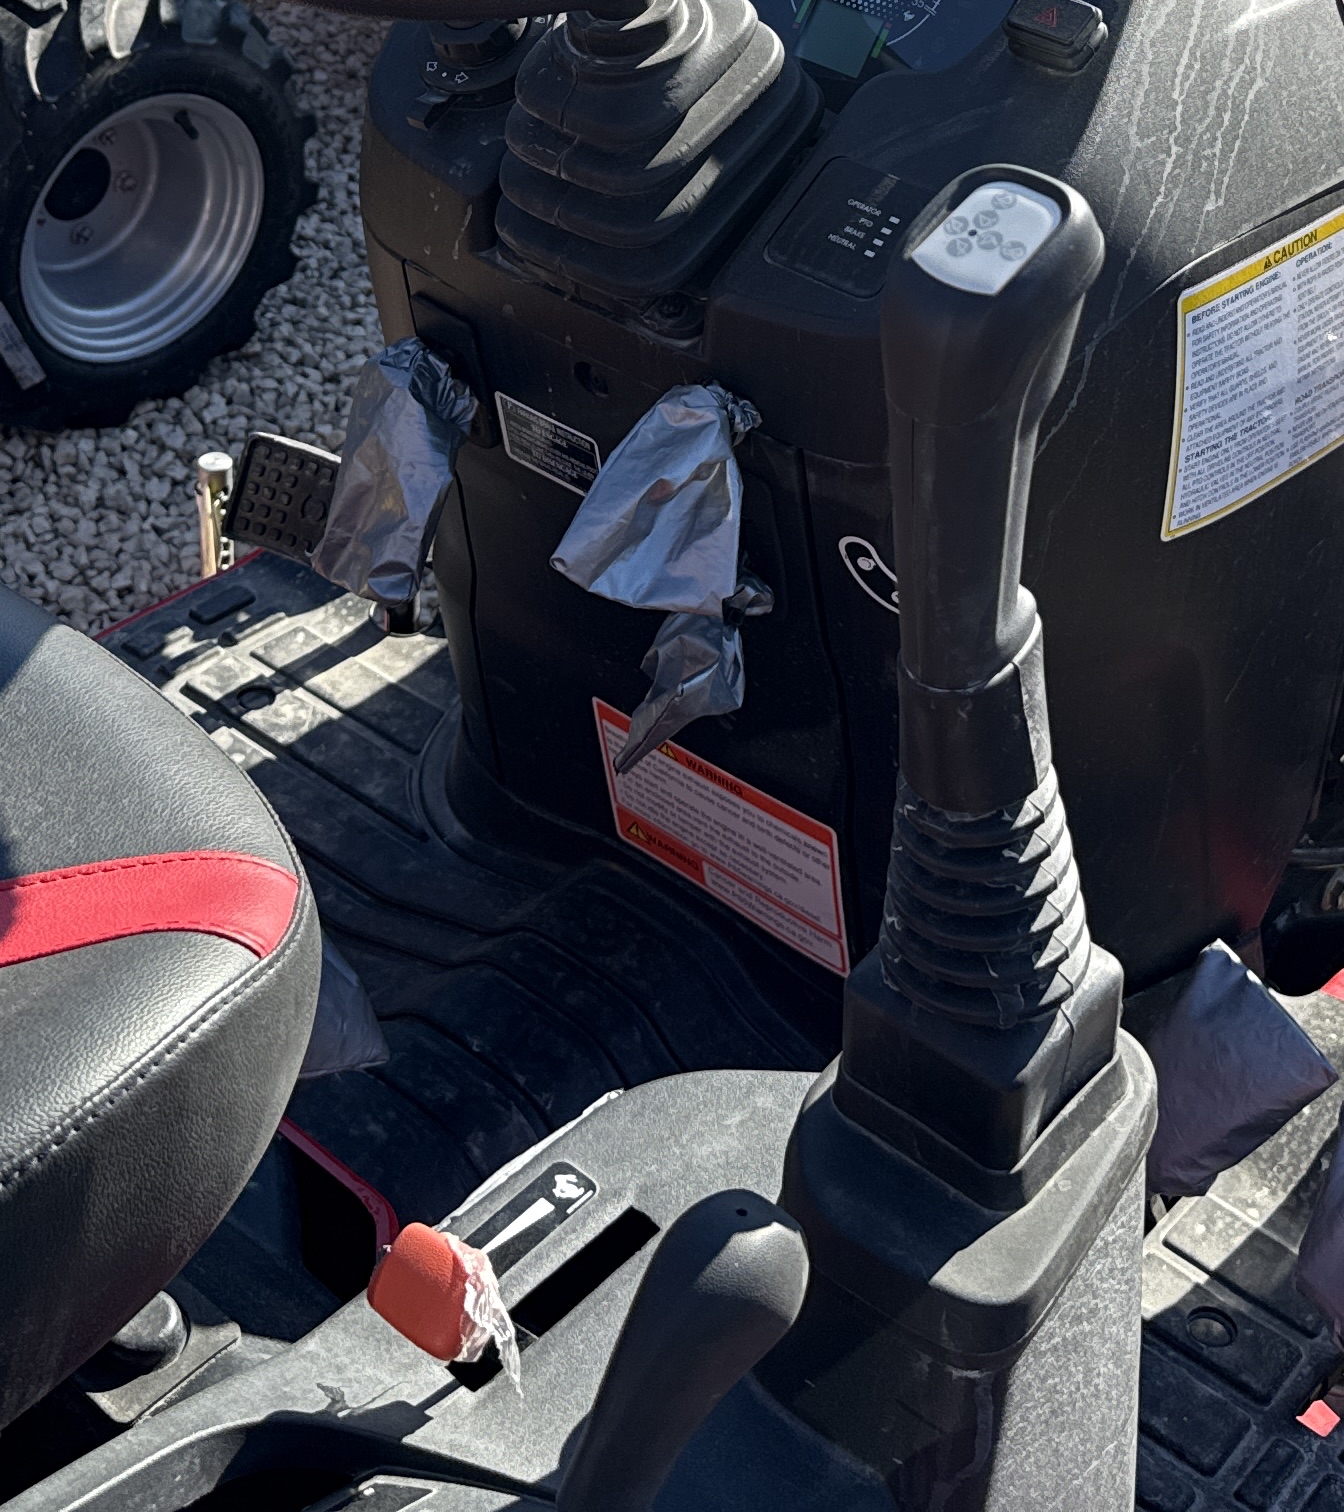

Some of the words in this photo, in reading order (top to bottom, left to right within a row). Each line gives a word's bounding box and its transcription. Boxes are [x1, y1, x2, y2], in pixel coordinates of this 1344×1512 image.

[847, 198, 882, 217] OPERATOR
[858, 217, 874, 228] PTO
[1272, 229, 1318, 265] CAUTION
[1191, 302, 1221, 324] BEFORE
[1221, 284, 1255, 310] STARTING
[1184, 440, 1223, 464] STARTING
[1224, 433, 1238, 447] THE
[685, 756, 744, 799] WARNING
[645, 831, 700, 872] WARNING
